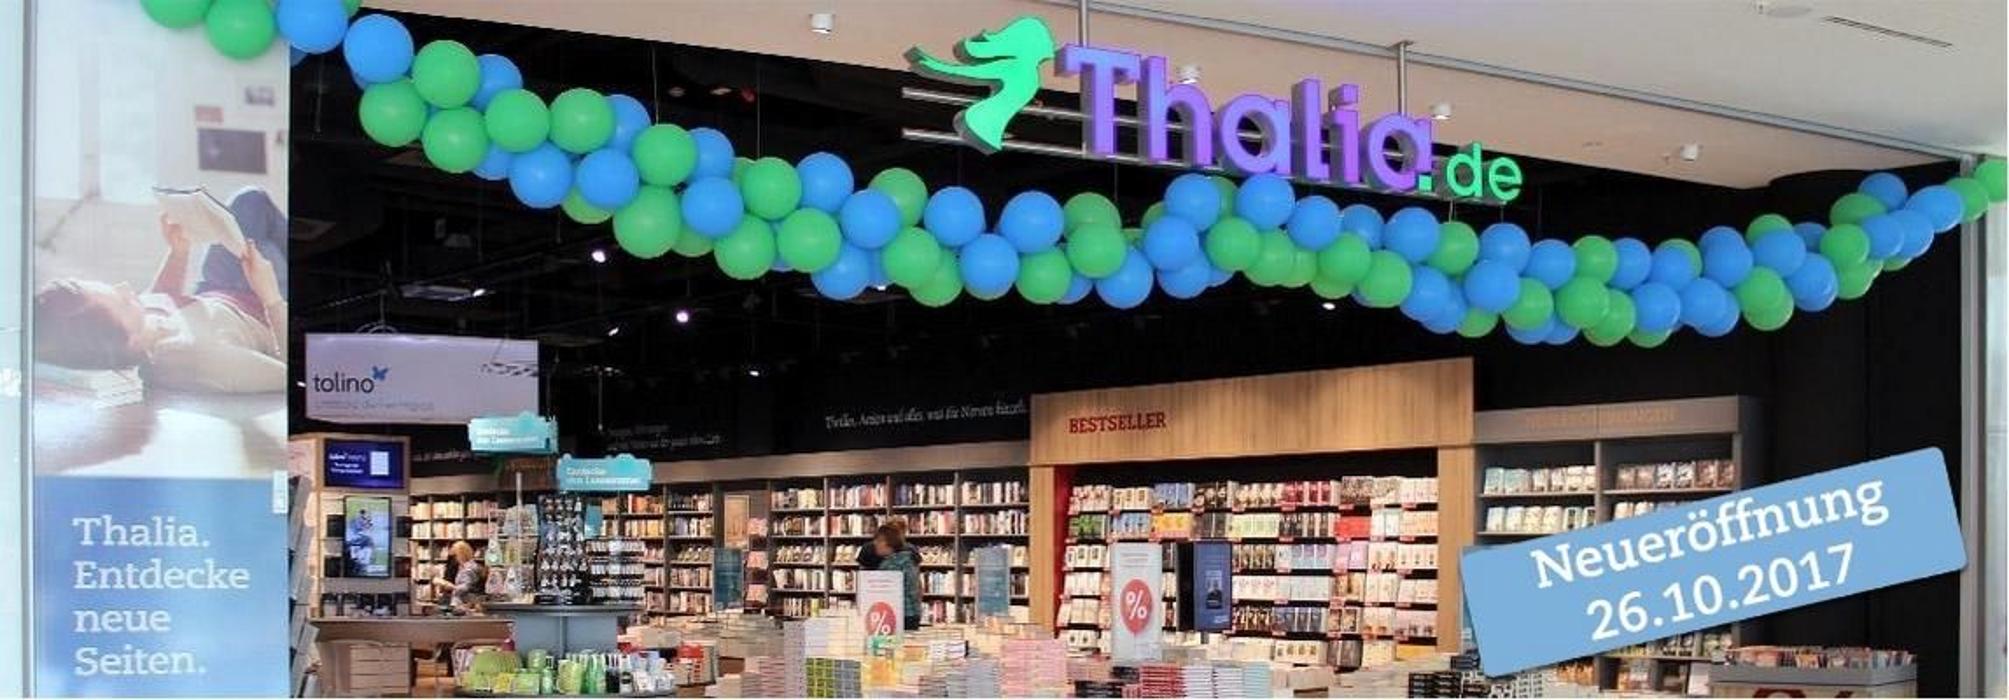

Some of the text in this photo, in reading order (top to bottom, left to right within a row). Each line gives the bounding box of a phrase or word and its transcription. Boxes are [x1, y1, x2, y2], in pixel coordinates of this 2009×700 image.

[314, 371, 375, 394] tolino
[1069, 412, 1167, 434] BESTSELLER
[72, 515, 211, 547] Thalia.
[73, 558, 250, 590] Entdecke
[73, 608, 172, 634] neue
[74, 643, 207, 677] Seiten.
